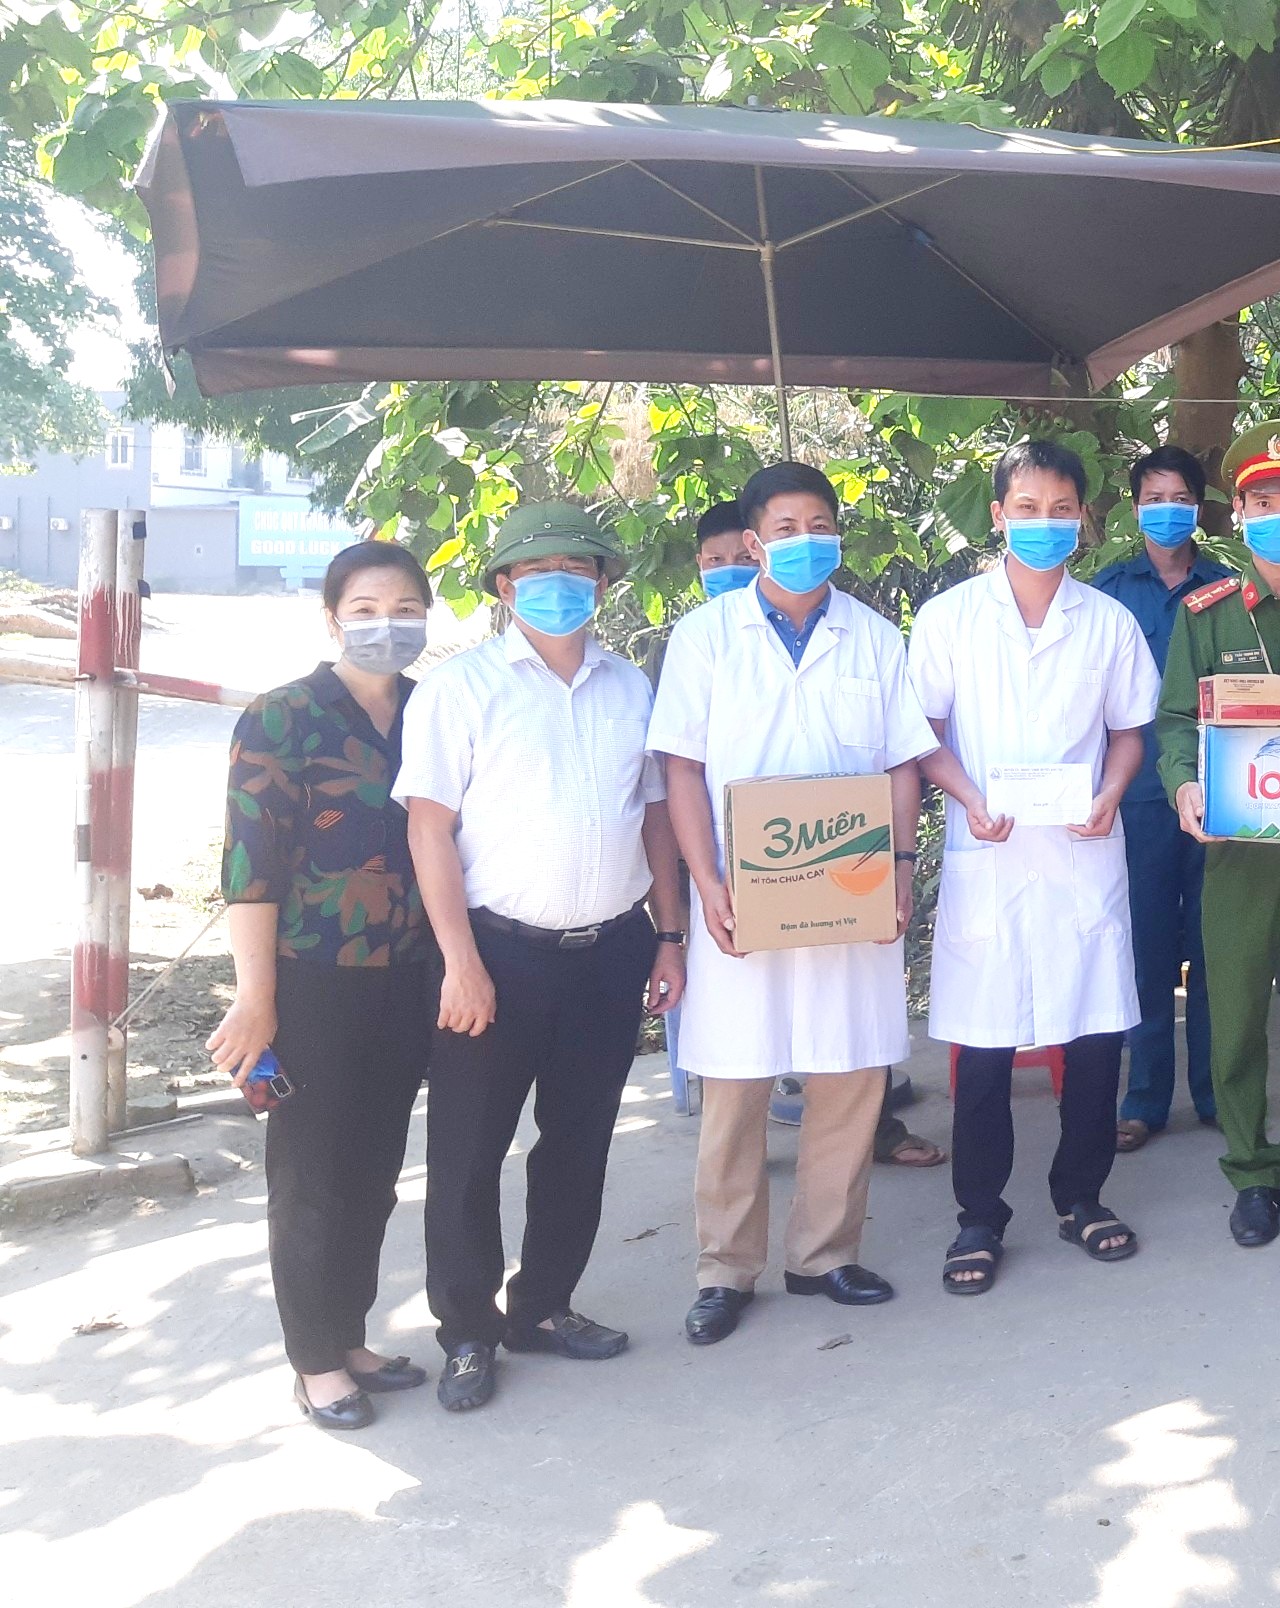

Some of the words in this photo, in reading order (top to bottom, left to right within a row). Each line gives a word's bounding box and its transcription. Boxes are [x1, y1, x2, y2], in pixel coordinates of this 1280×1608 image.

[251, 539, 296, 555] GOOD
[763, 817, 794, 859] 3
[792, 811, 867, 855] Miền
[751, 875, 760, 884] MÌ
[779, 874, 805, 884] CHUA
[807, 868, 825, 880] CAY
